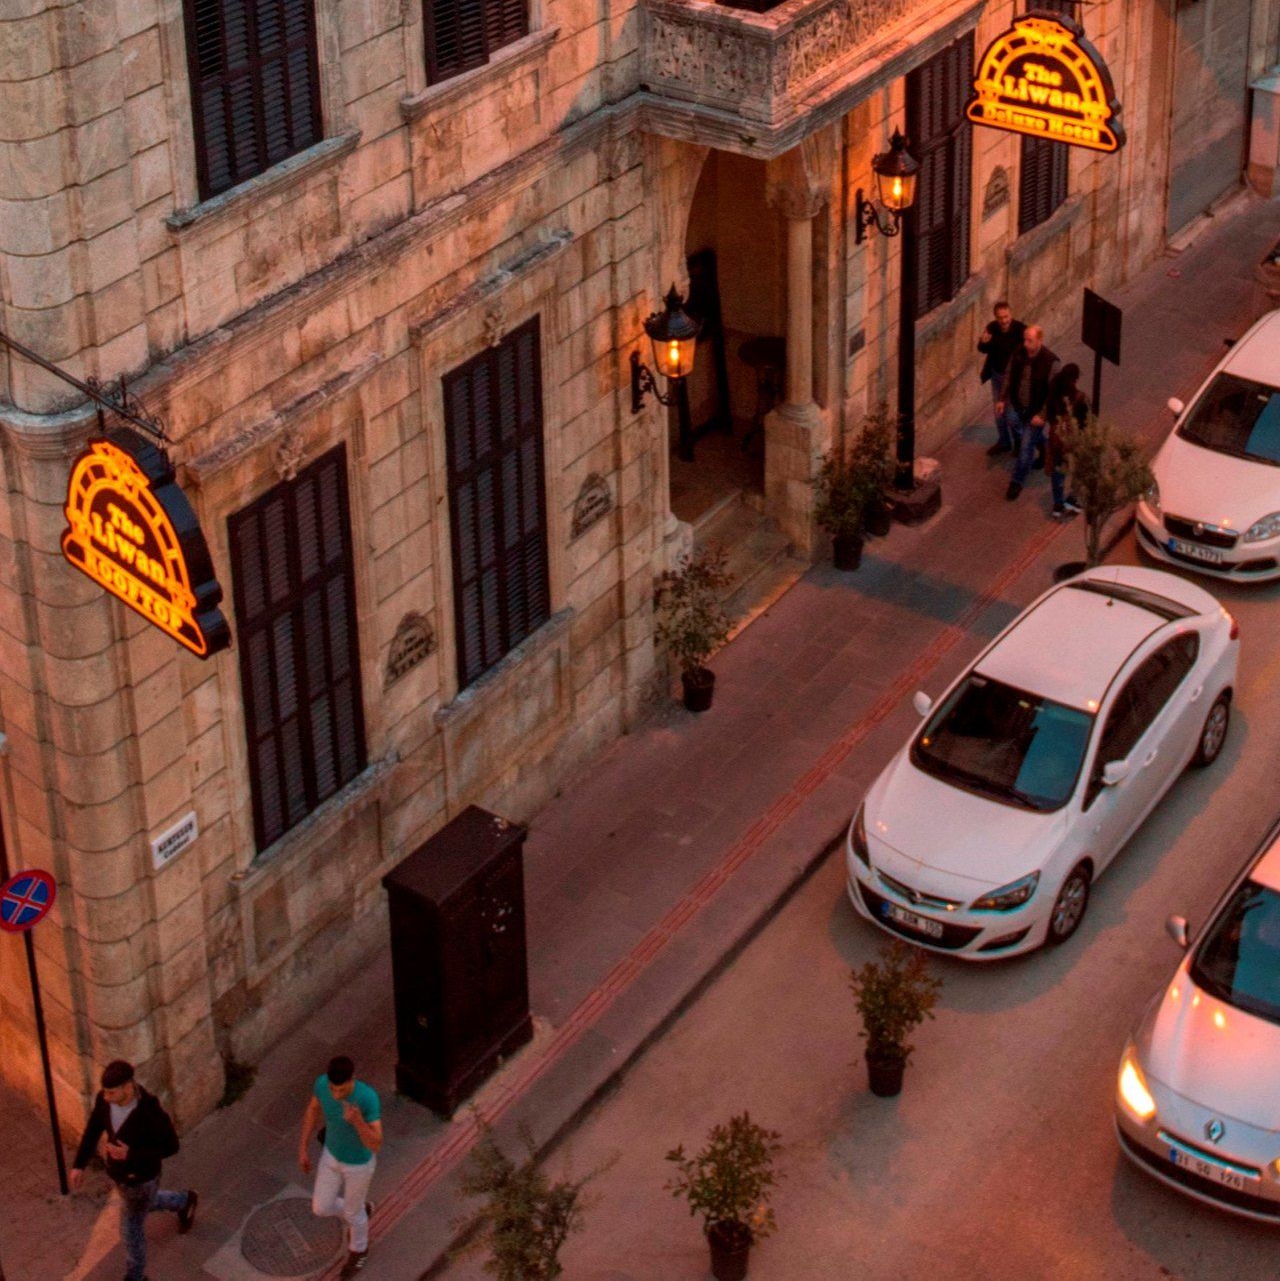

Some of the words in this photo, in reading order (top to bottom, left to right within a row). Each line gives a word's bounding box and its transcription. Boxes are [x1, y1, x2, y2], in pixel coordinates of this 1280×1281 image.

[1003, 74, 1081, 111] Liwan
[1022, 62, 1063, 87] The
[983, 105, 1046, 131] Deluxe
[1048, 118, 1101, 142] Hotel
[107, 502, 145, 545] The
[92, 511, 167, 585] Liwan
[84, 554, 184, 631] ROOFTOP
